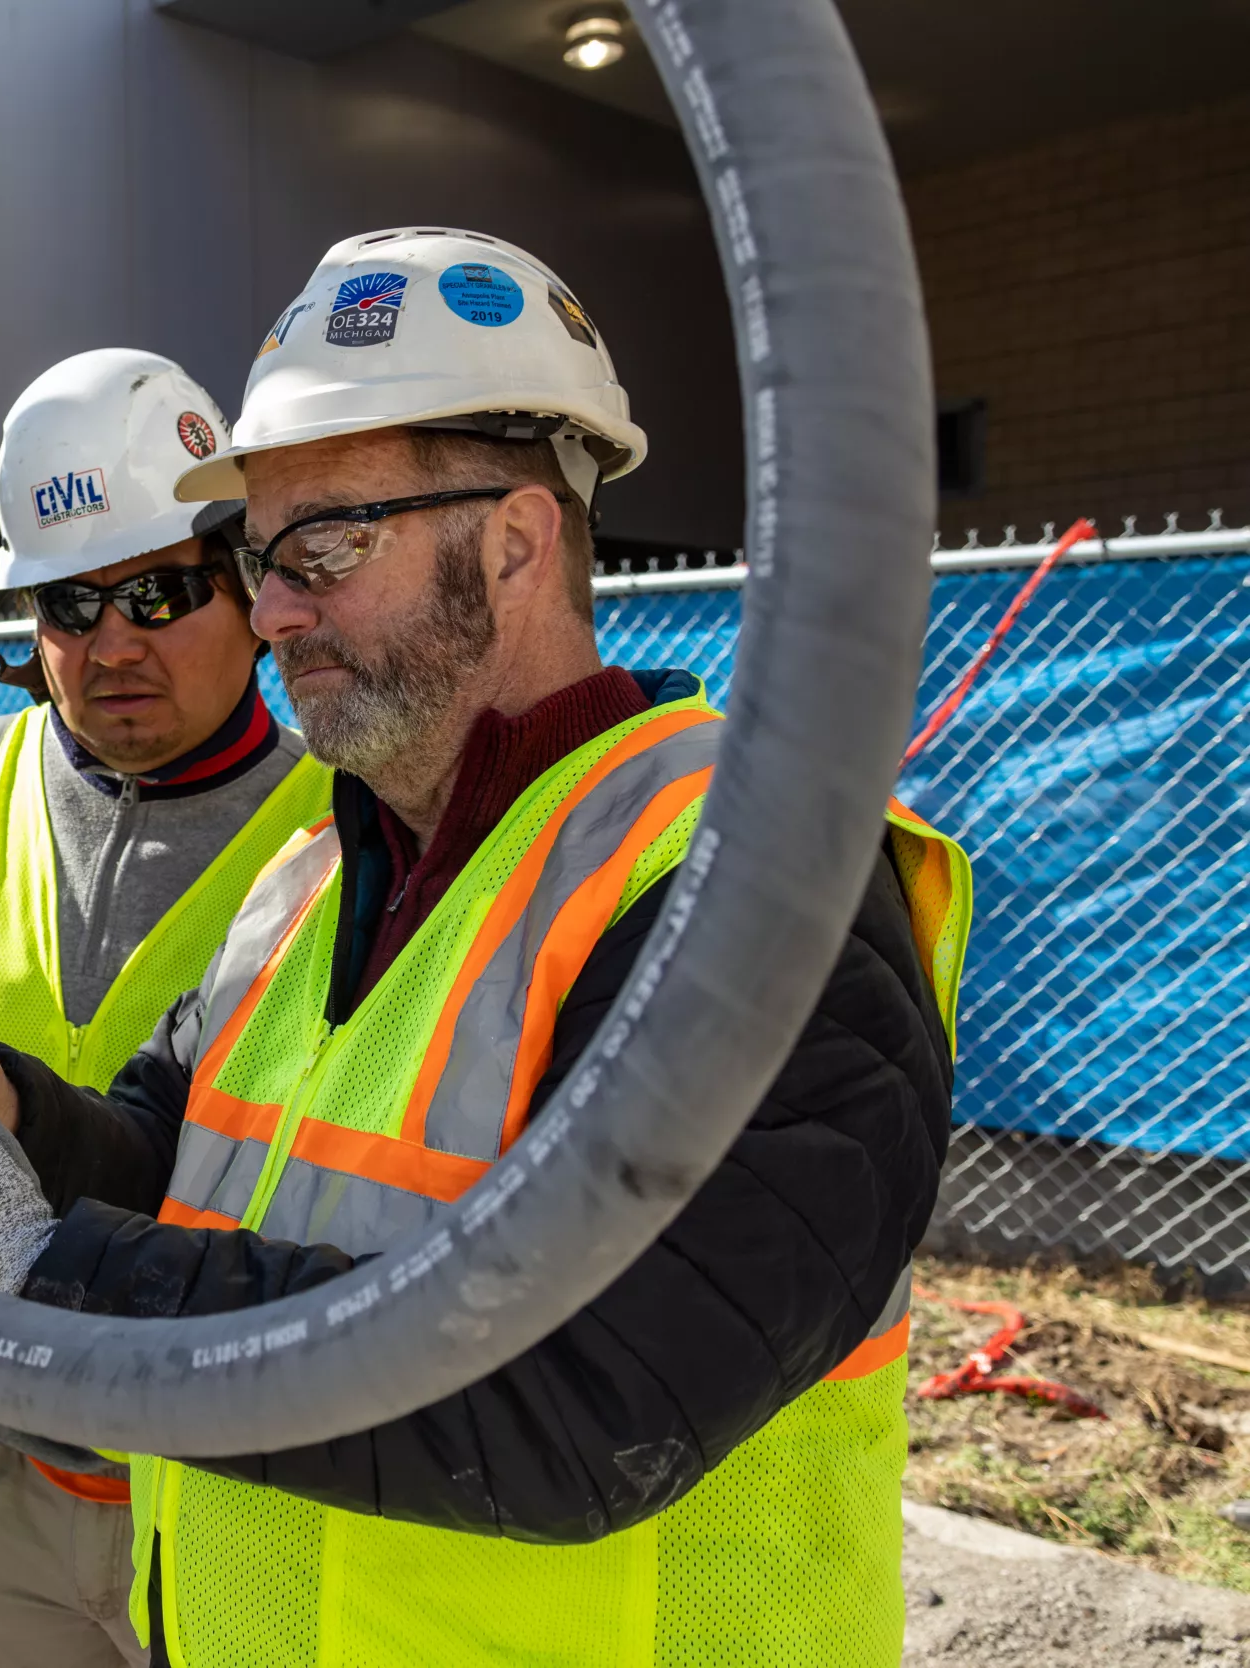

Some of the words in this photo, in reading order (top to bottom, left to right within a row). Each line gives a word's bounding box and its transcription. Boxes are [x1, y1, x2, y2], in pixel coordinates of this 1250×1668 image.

[332, 312, 393, 329] OE324
[471, 311, 502, 322] 2019
[329, 330, 390, 339] MICHIGAN
[36, 472, 102, 517] CIVIL
